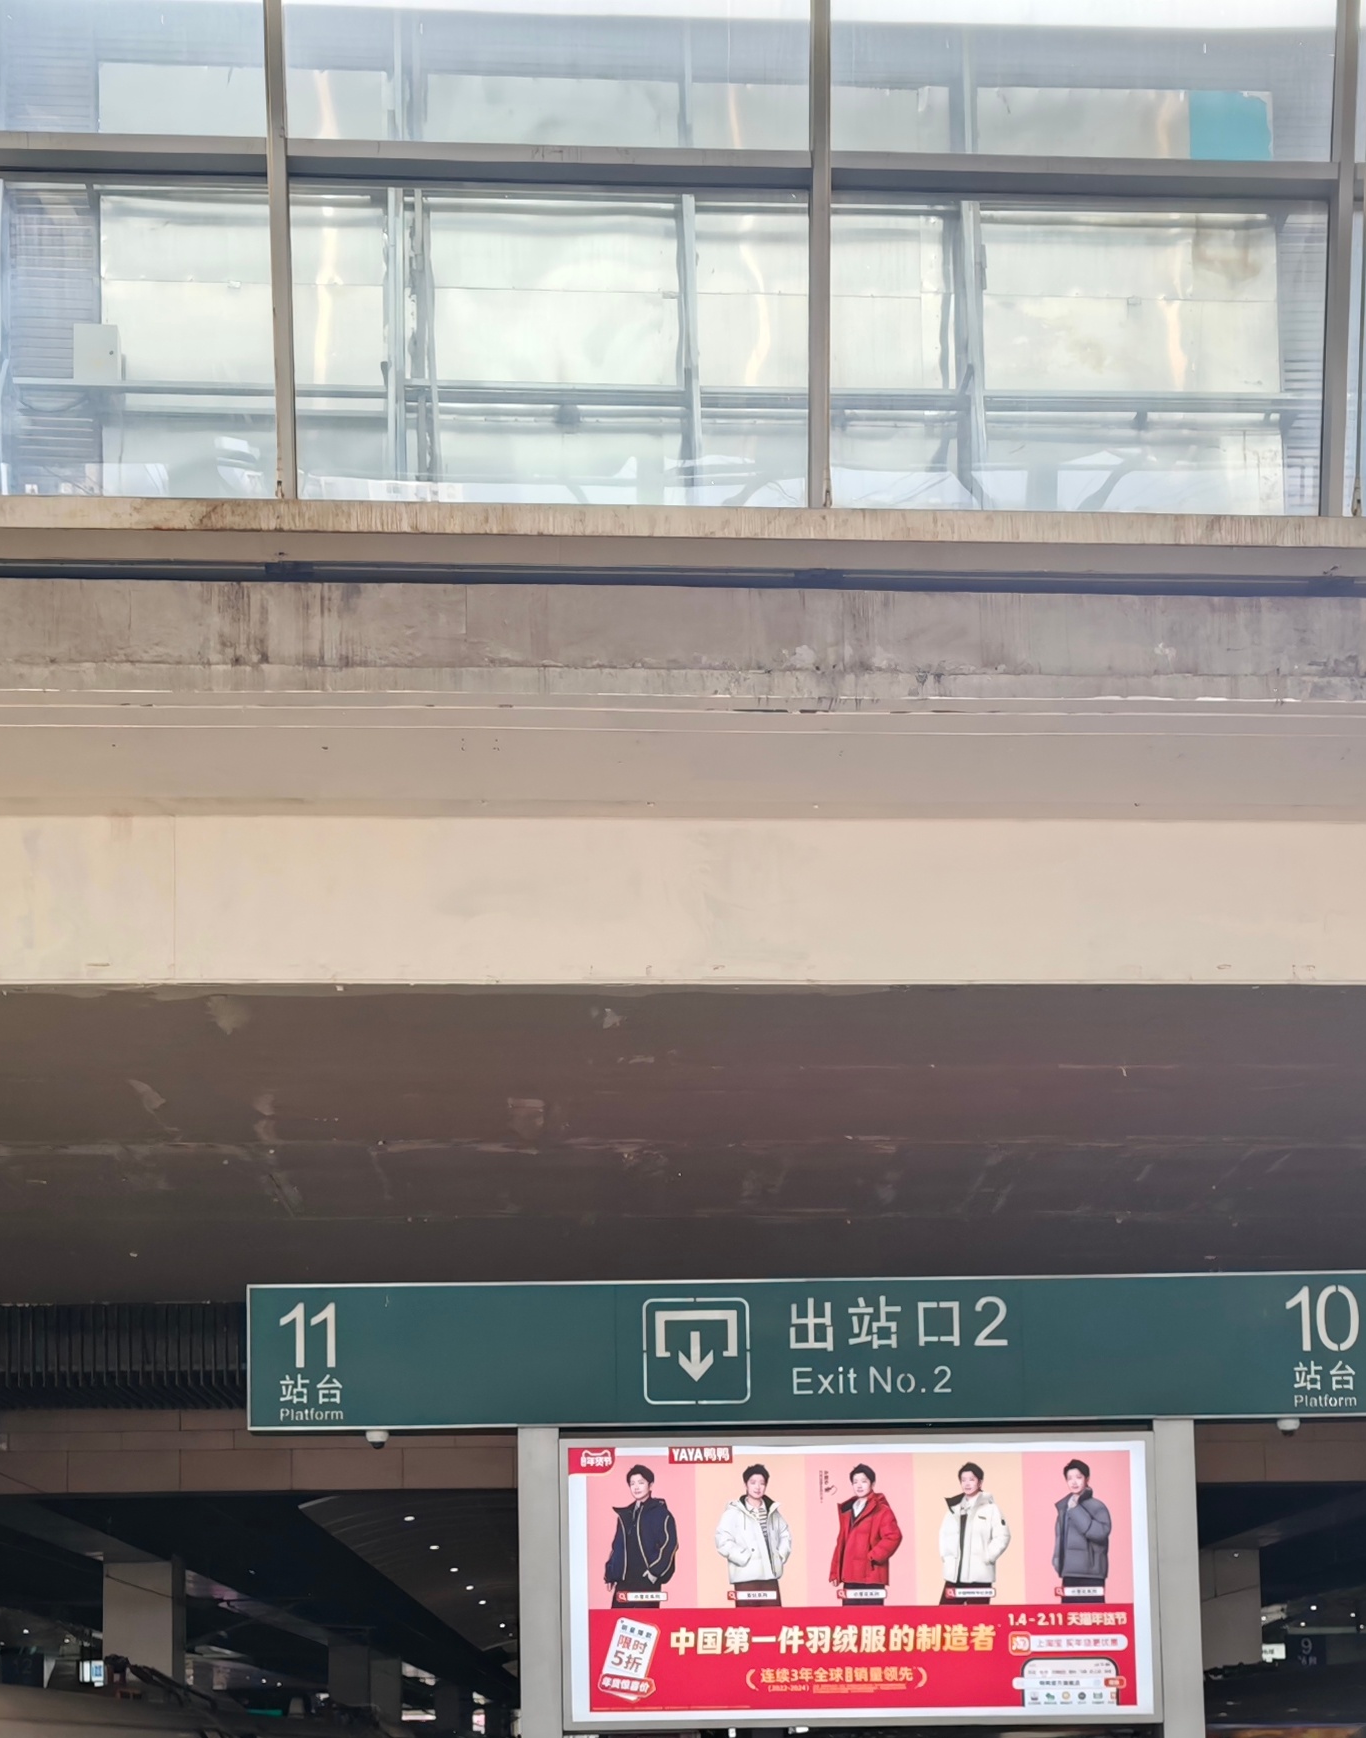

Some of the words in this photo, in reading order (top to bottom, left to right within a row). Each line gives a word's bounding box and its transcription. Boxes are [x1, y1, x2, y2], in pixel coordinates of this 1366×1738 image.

[789, 1295, 1009, 1352] 出站口2
[1285, 1284, 1360, 1352] 10
[279, 1302, 336, 1369] 11
[279, 1373, 343, 1405] 站台
[792, 1366, 858, 1395] Exit
[869, 1365, 952, 1394] No.2
[1293, 1360, 1356, 1391] 站台
[279, 1407, 344, 1421] Platform
[1293, 1393, 1357, 1408] Platform
[616, 1634, 648, 1655] 限时
[670, 1623, 996, 1656] 中国第一件羽绒服的制造者
[610, 1650, 643, 1674] 5折
